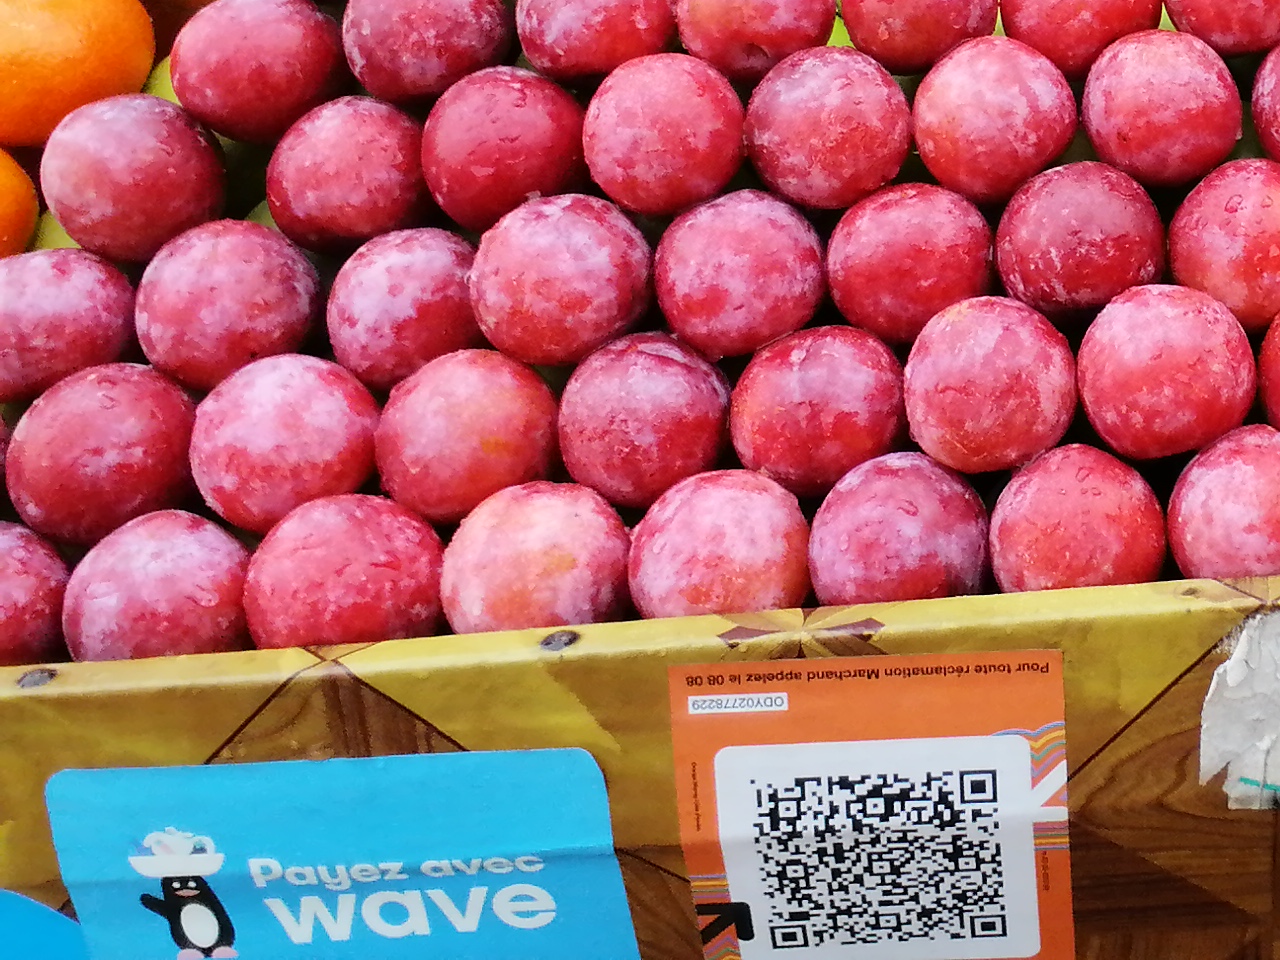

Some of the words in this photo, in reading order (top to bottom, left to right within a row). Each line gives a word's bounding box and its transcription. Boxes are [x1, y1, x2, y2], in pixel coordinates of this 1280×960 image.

[806, 668, 880, 682] Marchand
[884, 664, 970, 679] réclamation
[974, 663, 1011, 675] toute
[1015, 662, 1049, 674] Pour
[728, 673, 741, 685] le
[745, 670, 802, 684] appelez
[691, 696, 785, 711] ODY02778229
[248, 857, 410, 891] Payez
[419, 854, 545, 878] avec
[262, 883, 557, 945] wave
